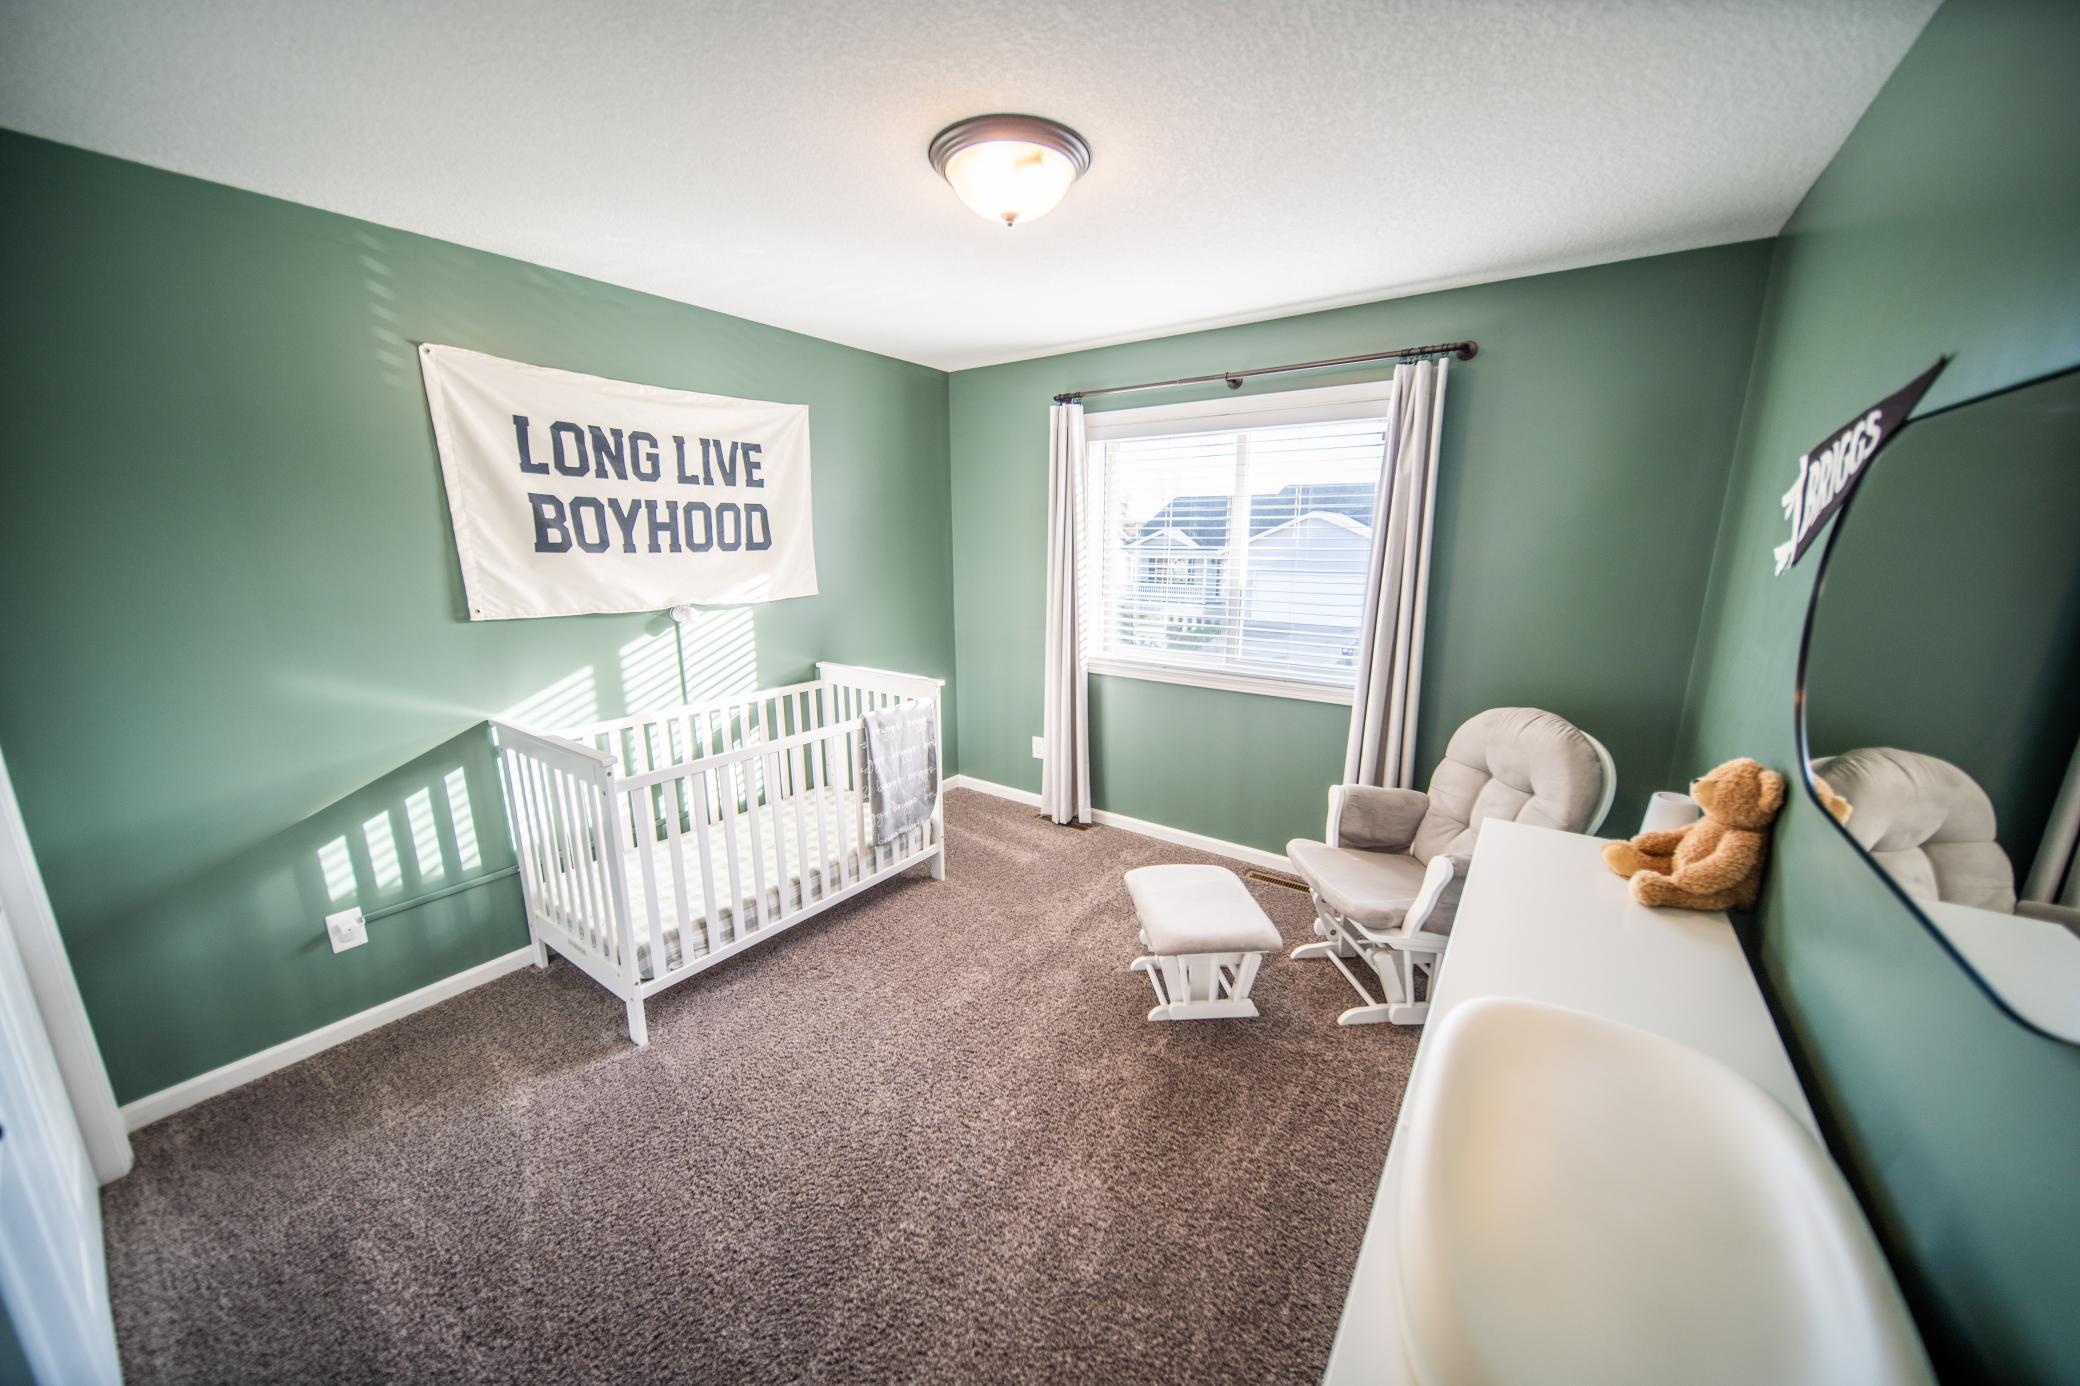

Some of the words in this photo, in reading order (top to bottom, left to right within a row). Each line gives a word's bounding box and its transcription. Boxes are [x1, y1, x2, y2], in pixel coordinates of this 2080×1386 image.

[513, 414, 661, 482] LONG
[672, 435, 765, 489] LIVE
[1798, 409, 1882, 543] BRIGGS
[527, 492, 773, 554] BOYHOOD
